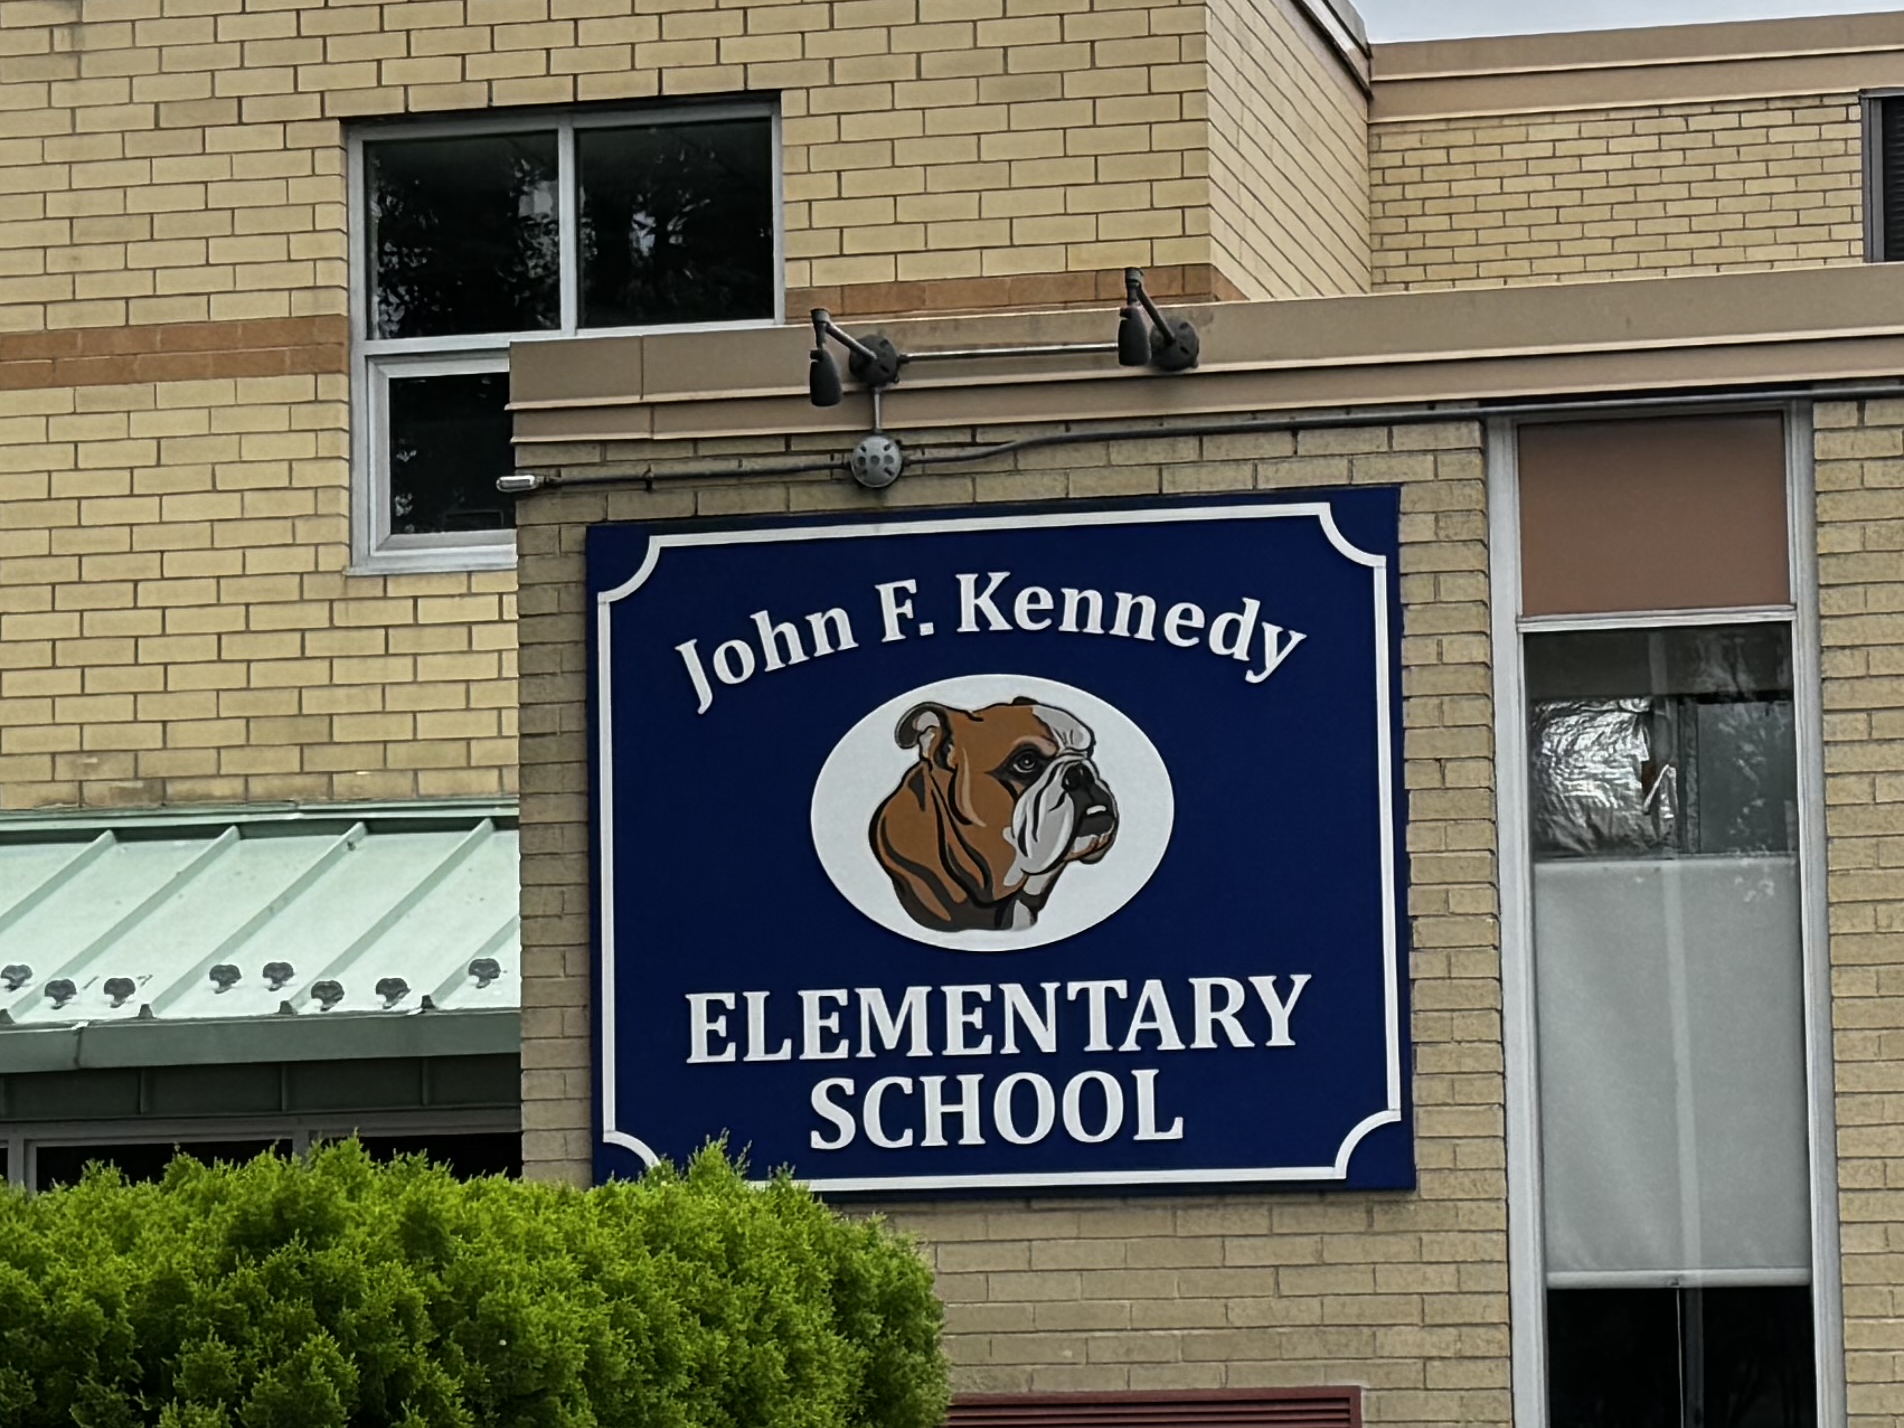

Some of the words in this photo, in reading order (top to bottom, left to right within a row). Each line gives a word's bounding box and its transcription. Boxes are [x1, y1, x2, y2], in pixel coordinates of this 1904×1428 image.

[674, 607, 860, 715] John
[874, 577, 936, 643] F.
[955, 571, 1308, 684] Kennedy
[684, 974, 1313, 1064] ELEMENTARY
[809, 1068, 1185, 1150] SCHOOL
